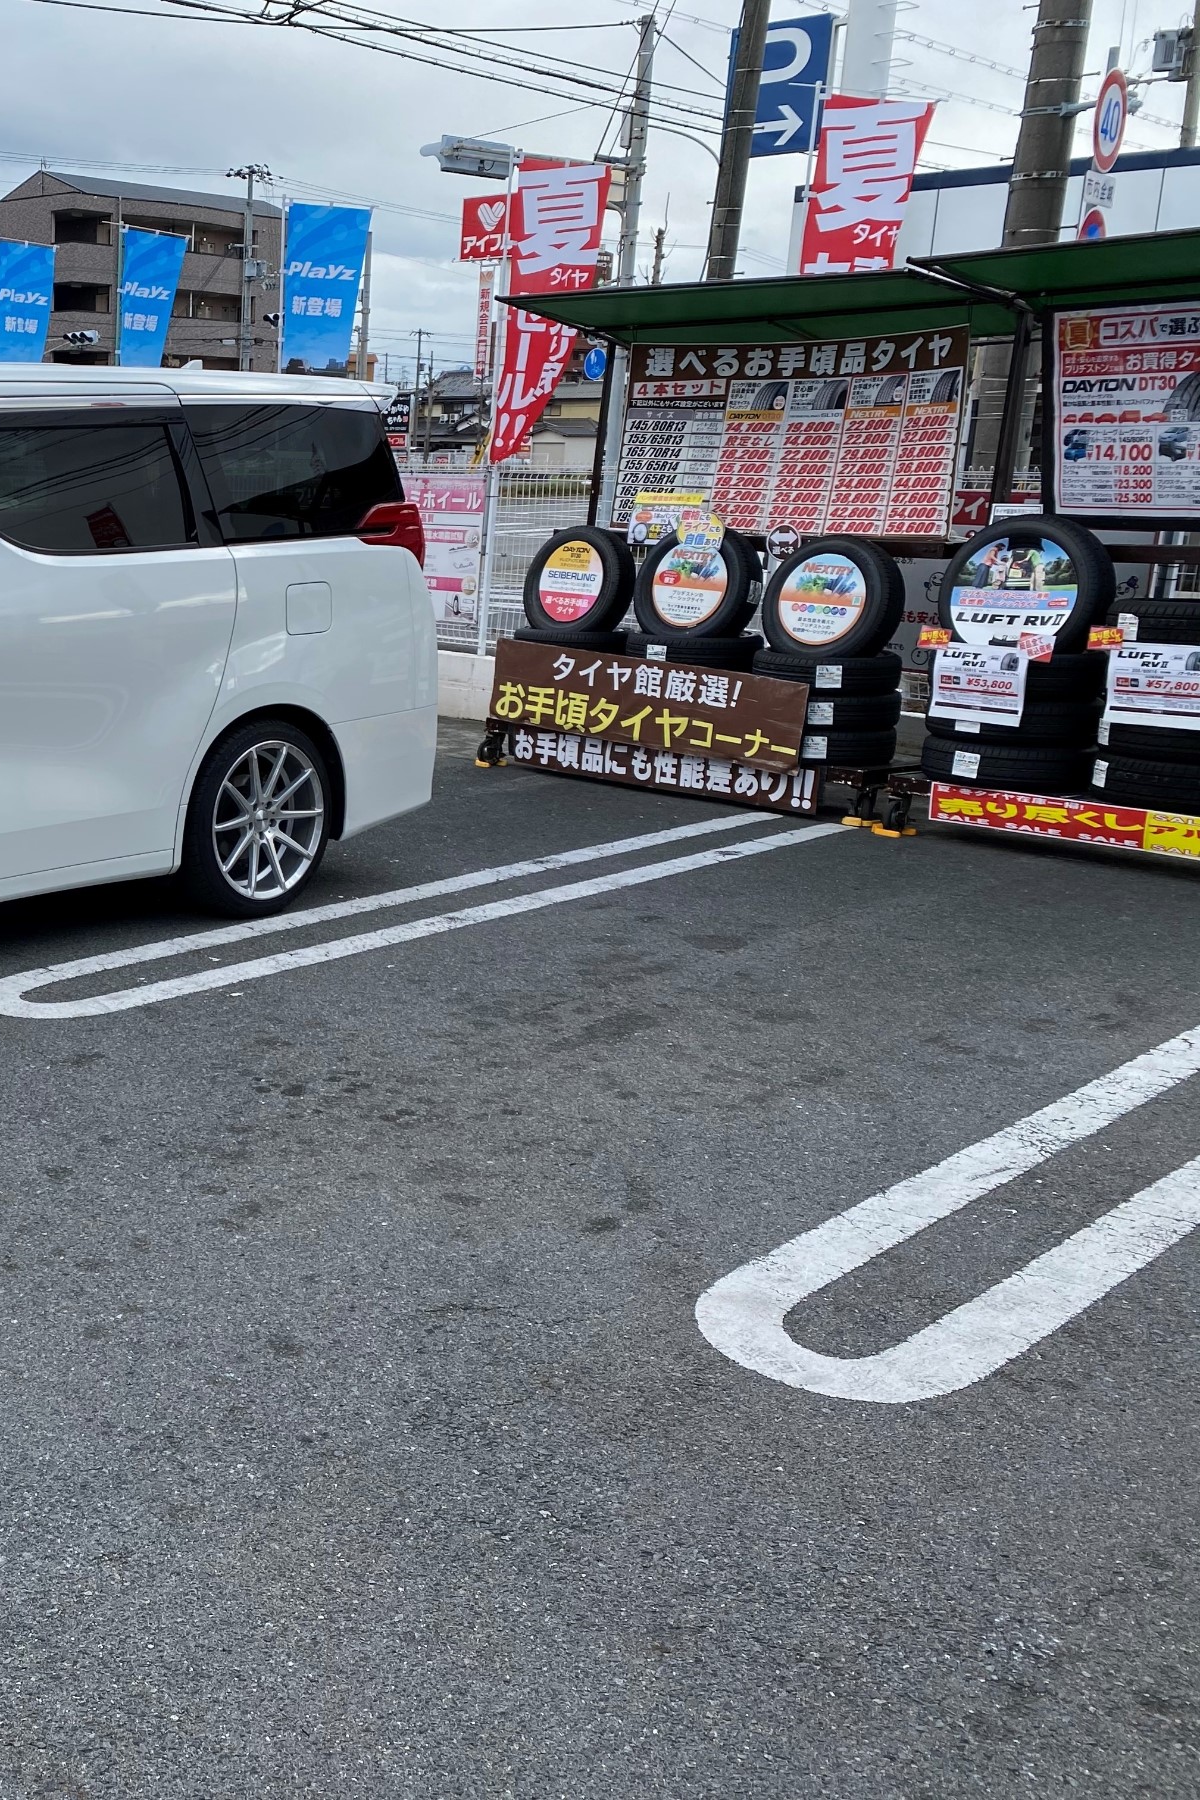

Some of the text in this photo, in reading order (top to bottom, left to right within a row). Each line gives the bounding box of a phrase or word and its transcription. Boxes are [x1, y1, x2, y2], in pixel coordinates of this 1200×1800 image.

[1101, 98, 1120, 142] 40
[816, 102, 927, 232] 夏
[517, 165, 606, 275] 夏
[550, 267, 590, 288] タイヤ
[291, 295, 343, 318] 新登場
[4, 316, 39, 335] 新登場
[124, 311, 159, 332] 新登場
[645, 335, 953, 377] 選べるお手頃品タイヤ
[1062, 375, 1177, 393] DAYTON DT30
[850, 409, 888, 418] NEXTRY
[913, 405, 950, 415] NEXTRY
[629, 420, 687, 432] 145/80R13
[627, 434, 685, 446] 155/65R13
[724, 435, 774, 446] 設定なし
[625, 447, 682, 459] 165/70R14
[623, 460, 680, 472] 155/65R14
[621, 473, 677, 485] 175/65R14
[405, 491, 482, 511] ミホイール
[684, 523, 721, 533] ライフにも
[684, 534, 722, 547] 自信あり!
[672, 549, 718, 561] NEXTRY
[772, 546, 795, 555] 選べる
[802, 562, 856, 575] NEXTRY
[548, 571, 597, 582] SEIBERLING
[556, 607, 574, 615] タイヤ
[955, 612, 1021, 625] LUFT
[942, 651, 982, 660] LUFT
[1118, 651, 1163, 660] LUFT
[552, 653, 743, 709] タイヤ館厳選!
[966, 677, 1012, 690] ¥53,800
[495, 681, 797, 758] お手頃タイヤコーナー
[938, 797, 1144, 831] 売り尽くし
[937, 812, 1139, 847] SALE SALE SALE
[1151, 844, 1200, 857] SAL
